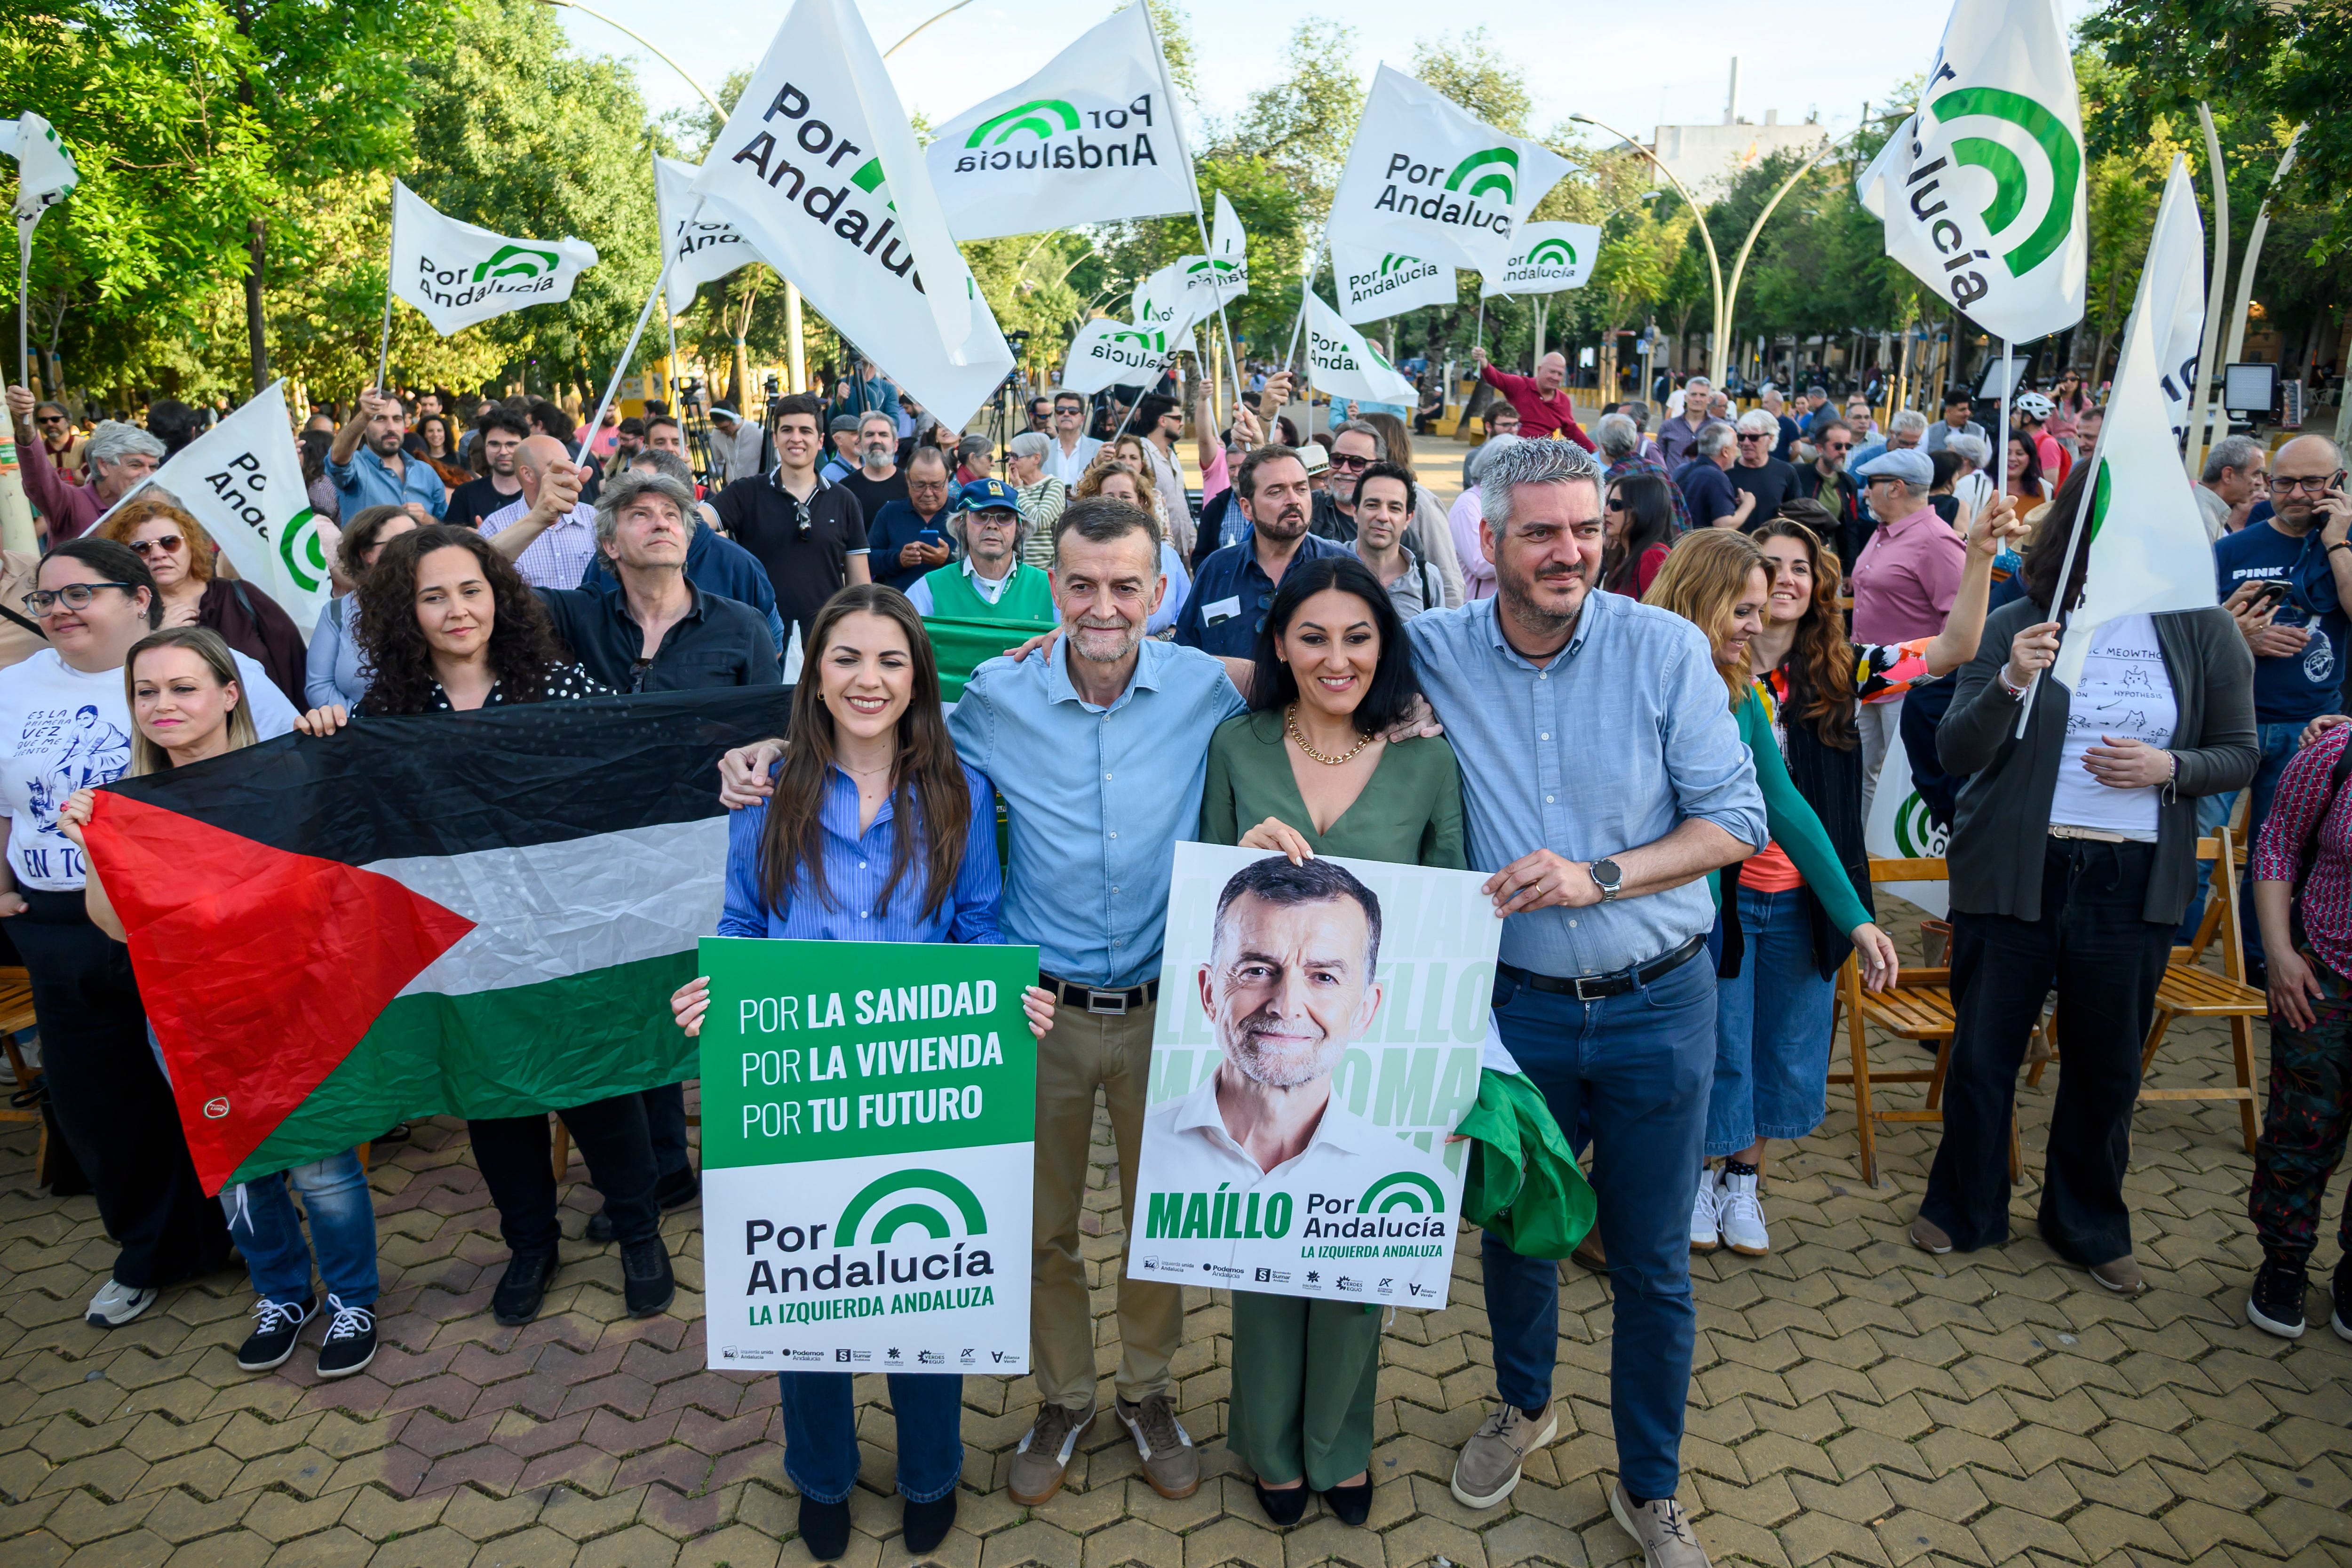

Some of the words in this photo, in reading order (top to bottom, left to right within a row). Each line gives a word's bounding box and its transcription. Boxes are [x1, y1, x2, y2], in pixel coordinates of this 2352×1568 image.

[763, 82, 861, 168] Por
[1386, 153, 1445, 186] Por
[1374, 184, 1510, 240] Andaluc
[420, 255, 469, 285] Por
[1350, 270, 1378, 290] Por
[1503, 266, 1575, 281] ndalucía
[420, 276, 554, 307] Andalucía
[1351, 263, 1438, 305] Andalucía
[1311, 332, 1339, 352] Por
[2233, 566, 2283, 580] PINK
[2114, 690, 2162, 699] HYPOTHESIS
[24, 719, 72, 727] PRIMERA
[28, 711, 44, 719] ES
[48, 709, 67, 718] LA
[17, 740, 39, 749] QUE
[23, 726, 61, 739] VEZ
[13, 748, 49, 757] SIENTO
[24, 849, 51, 877] EN
[740, 996, 799, 1034] POR
[808, 992, 846, 1029] LA
[855, 979, 997, 1025] SANIDAD
[742, 1049, 801, 1087] POR
[810, 1045, 847, 1081] LA
[856, 1032, 1003, 1077] VIVIENDA
[743, 1101, 801, 1138] POR
[808, 1097, 848, 1133] TU
[859, 1085, 983, 1128] FUTURO
[1145, 1182, 1293, 1239] MAÍLLO
[1307, 1193, 1355, 1214] Por
[746, 1219, 827, 1255] Por
[1303, 1217, 1446, 1238] Andalucía
[1301, 1245, 1315, 1258] LA
[1318, 1245, 1380, 1259] IZQUIERDA
[1382, 1244, 1443, 1258] ANDALUZA
[746, 1242, 994, 1296] Andalucía
[1213, 1265, 1244, 1274] Podemos
[749, 1305, 773, 1326] LA
[779, 1296, 884, 1325] IZQUIERDA
[890, 1286, 994, 1314] ANDALUZA
